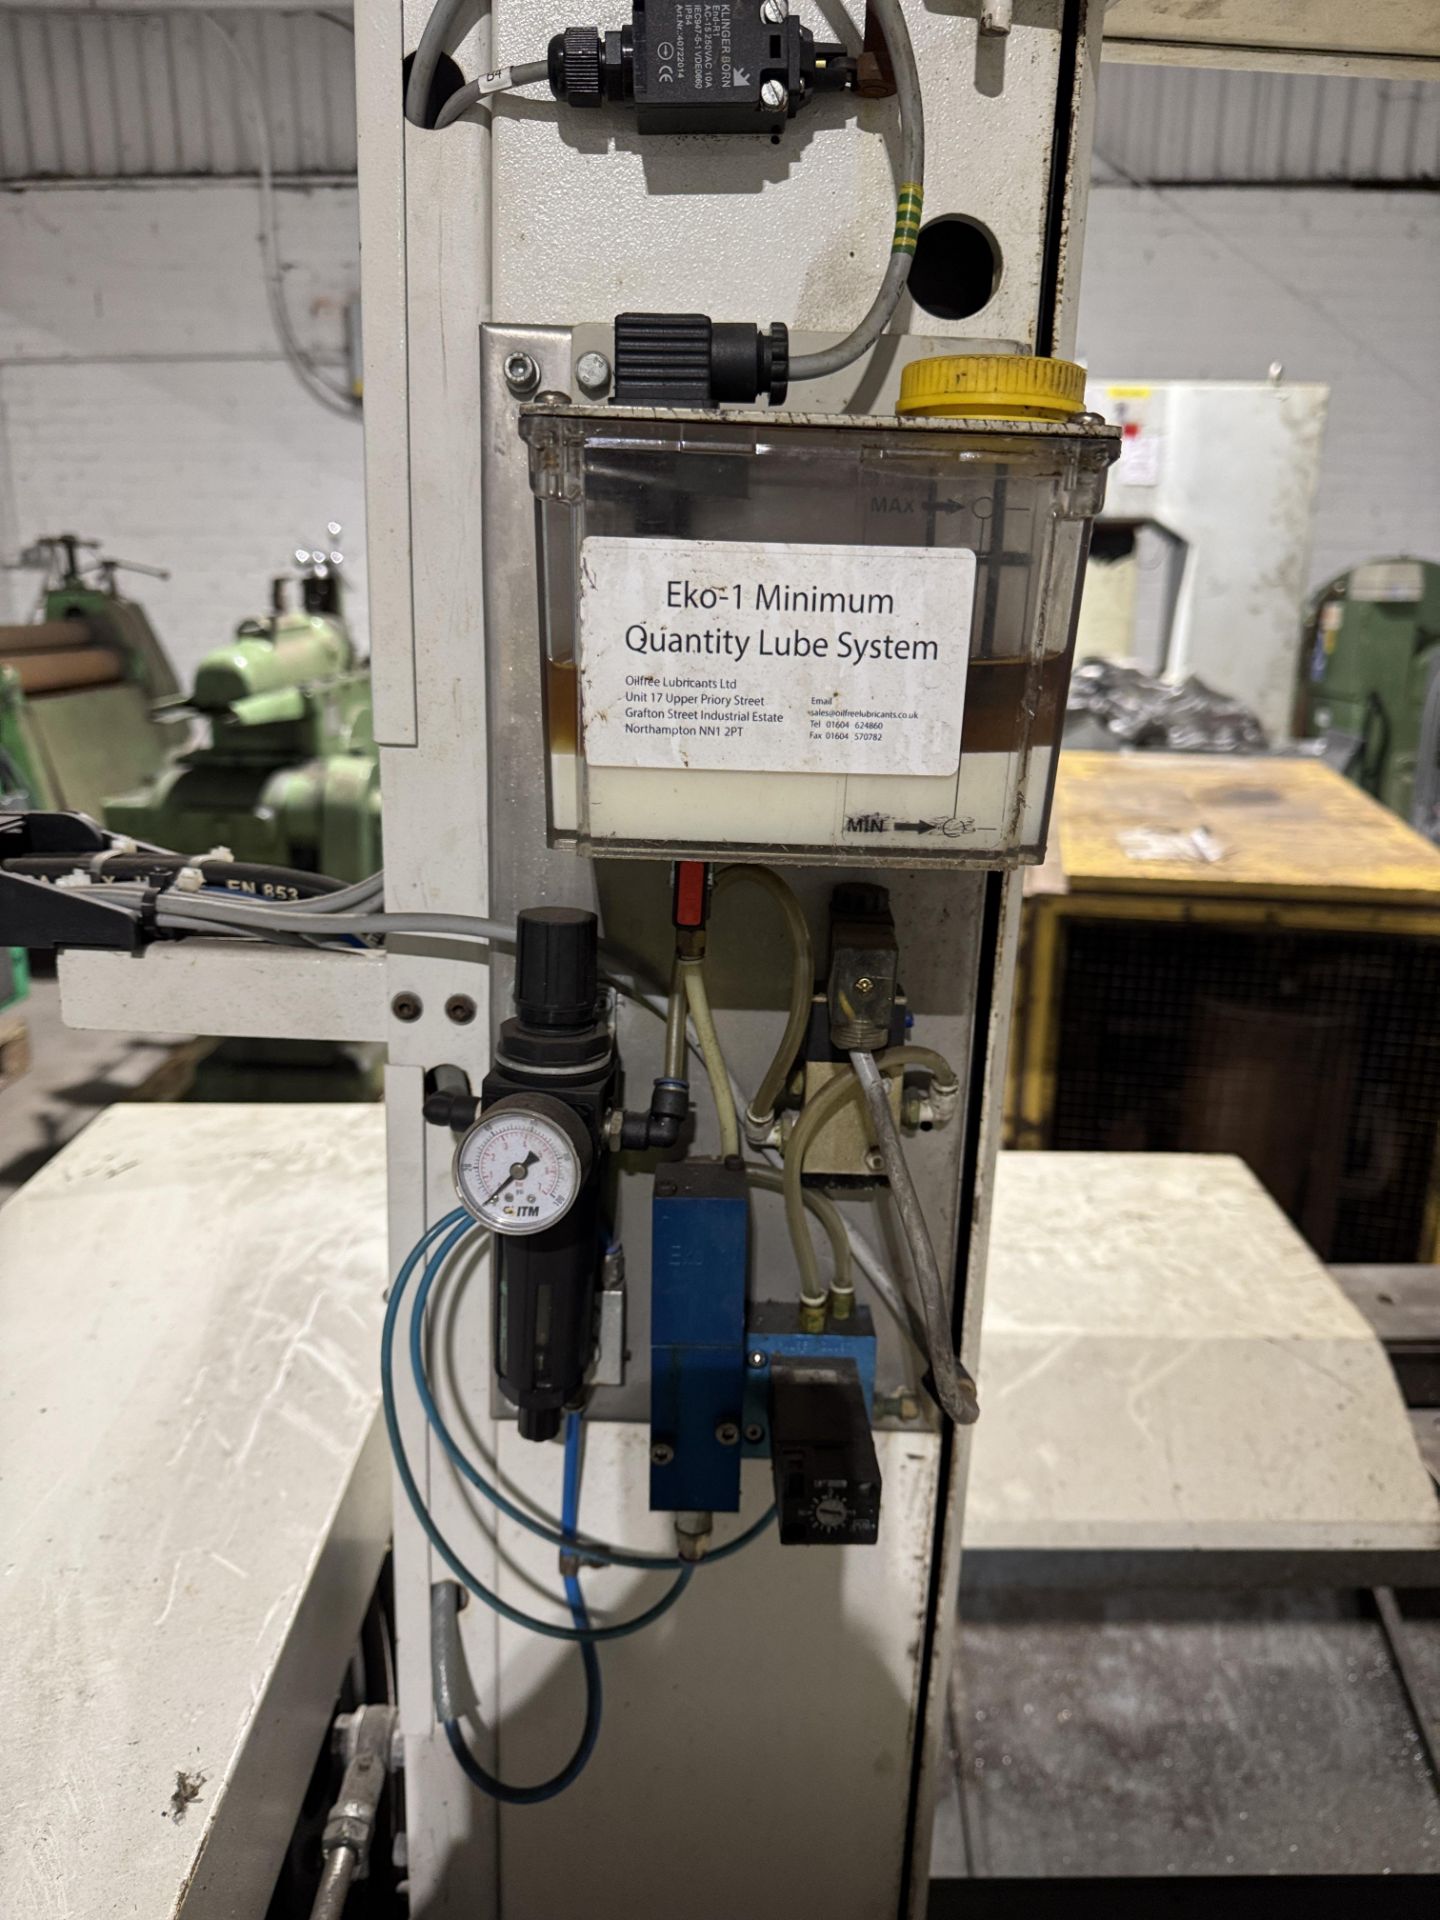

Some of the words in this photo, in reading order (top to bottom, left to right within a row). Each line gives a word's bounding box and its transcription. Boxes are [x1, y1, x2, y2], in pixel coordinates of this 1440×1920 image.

[685, 5, 693, 25] IP54
[704, 4, 712, 32] AC-15
[712, 5, 720, 36] End-R1
[721, 4, 731, 53] KLINGER
[704, 34, 712, 69] 250VAC
[694, 51, 703, 89] VDE0660
[721, 56, 731, 88] BORN
[704, 71, 712, 88] 10A
[871, 497, 914, 513] MAX
[667, 580, 742, 610] Eko-1
[755, 583, 894, 614] Minimum
[625, 624, 750, 663] Quantity
[759, 629, 828, 657] Lube
[837, 631, 939, 666] System
[625, 675, 660, 687] Oilfree
[663, 677, 717, 689] Lubricants
[720, 679, 737, 689] Ltd
[625, 692, 647, 702] Unit
[651, 693, 663, 703] 17
[666, 693, 698, 706] Upper
[701, 694, 732, 707] Priory
[734, 695, 765, 706] Street
[811, 697, 832, 705] Email
[625, 707, 665, 719] Grafton
[667, 709, 698, 720] Street
[701, 710, 750, 722] Industrial
[752, 712, 784, 723] Estate
[625, 723, 696, 737] Northampton
[700, 726, 720, 736] NN1
[724, 726, 744, 737] 2PT
[810, 720, 821, 728] Tel
[825, 721, 849, 729] 01604
[855, 722, 884, 730] 624860
[809, 731, 822, 739] Fax
[825, 732, 849, 740] 01604
[854, 732, 882, 741] 570782
[847, 817, 884, 833] MIN
[226, 879, 256, 893] EN
[263, 883, 298, 900] 853
[517, 1206, 540, 1217] ITM
